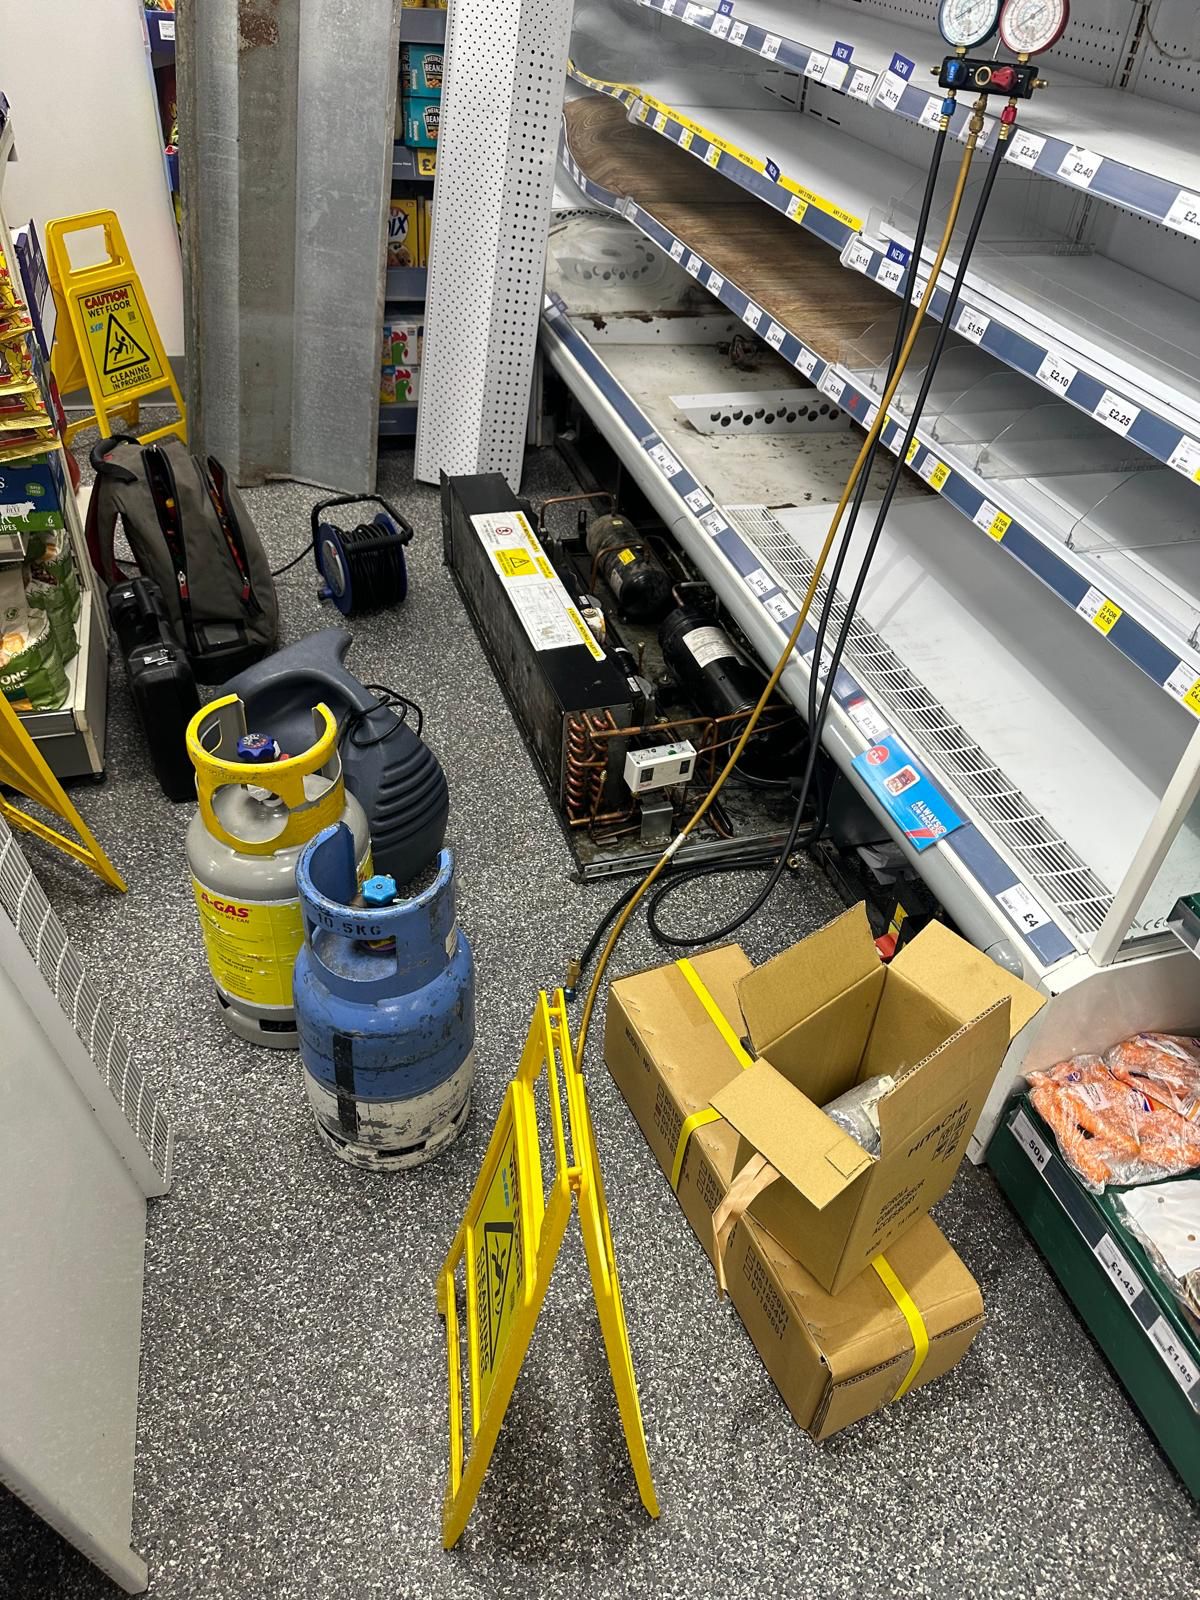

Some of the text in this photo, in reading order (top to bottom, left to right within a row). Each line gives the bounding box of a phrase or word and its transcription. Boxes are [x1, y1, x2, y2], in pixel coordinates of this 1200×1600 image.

[836, 47, 849, 59] NEW
[894, 60, 909, 75] NEW
[856, 82, 870, 94] £2.15
[885, 89, 899, 103] £1.75
[1020, 145, 1039, 160] £2.20
[1072, 162, 1093, 179] £2.40
[855, 254, 869, 267] £1.15
[890, 247, 906, 262] NEW
[885, 271, 899, 282] £1.20
[84, 288, 129, 310] CAUTION
[88, 300, 132, 319] WET FLOOR
[967, 323, 984, 336] £1.55
[110, 364, 150, 384] CLEANING
[1050, 369, 1070, 388] £2.10
[113, 373, 152, 391] IN PROGRESS
[1108, 408, 1132, 427] £2.25
[47, 515, 54, 523] 6
[709, 521, 721, 533] £1.50
[755, 579, 769, 593] £3.25
[1099, 612, 1112, 625] £4.50
[1107, 608, 1118, 620] FOR
[915, 800, 942, 830] ALWAYS
[201, 892, 249, 918] A-GAS
[1022, 913, 1039, 928] £4
[907, 1100, 968, 1158] HITACHI
[1111, 1261, 1135, 1297] £1.45
[1167, 1345, 1193, 1384] £1.85
